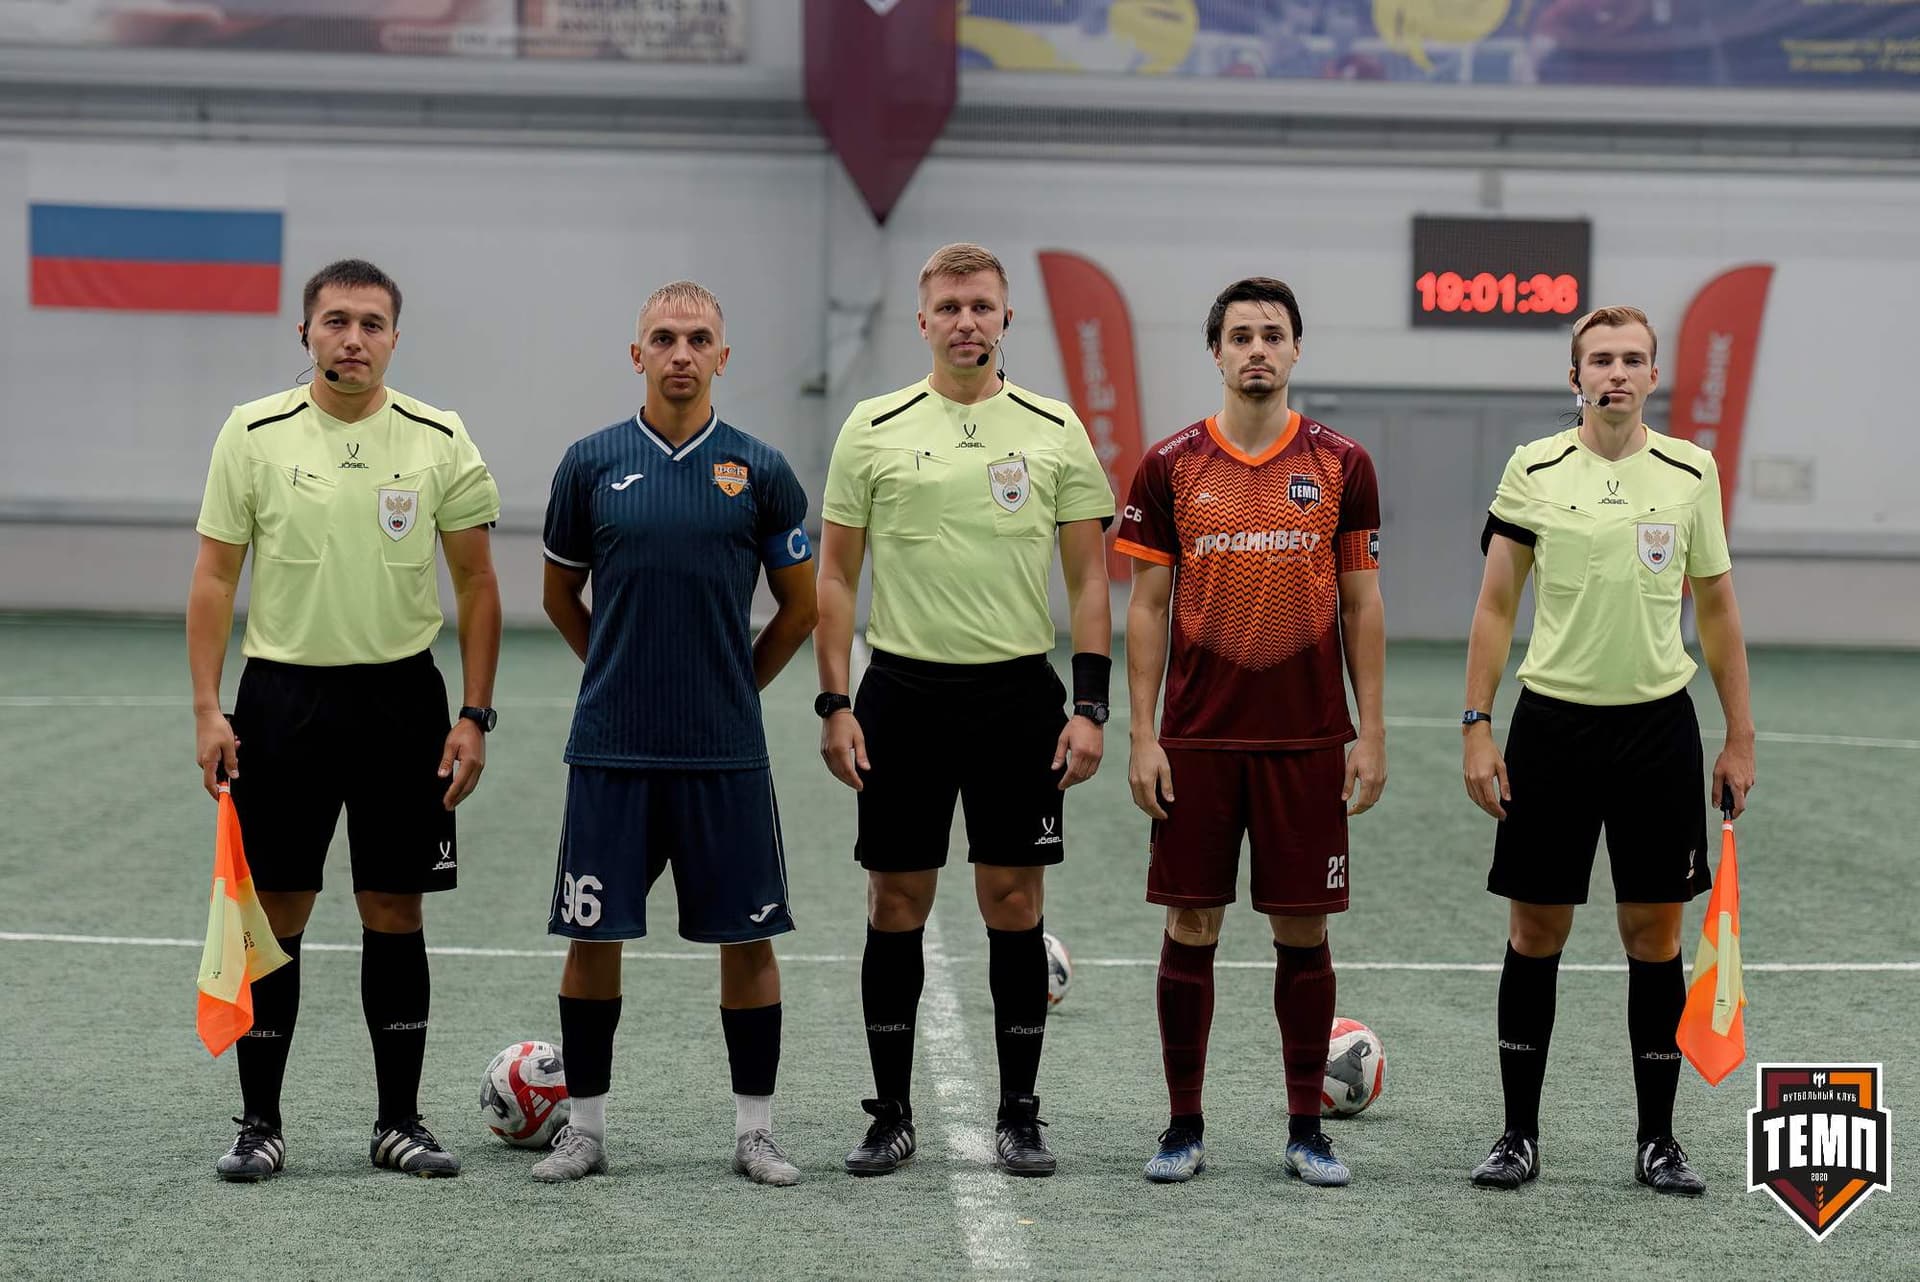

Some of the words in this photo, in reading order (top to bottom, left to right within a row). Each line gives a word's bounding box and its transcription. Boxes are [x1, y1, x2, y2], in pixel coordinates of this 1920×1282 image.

[337, 461, 369, 469] JÖGEL
[1291, 485, 1319, 501] ТЕМП
[1598, 497, 1629, 505] JÖGEL
[787, 527, 806, 560] C
[1034, 836, 1062, 845] JÖGEL
[1326, 855, 1345, 889] 23
[561, 872, 603, 927] 96
[244, 1030, 282, 1038] GEL
[1498, 1039, 1537, 1051] ÖGEL
